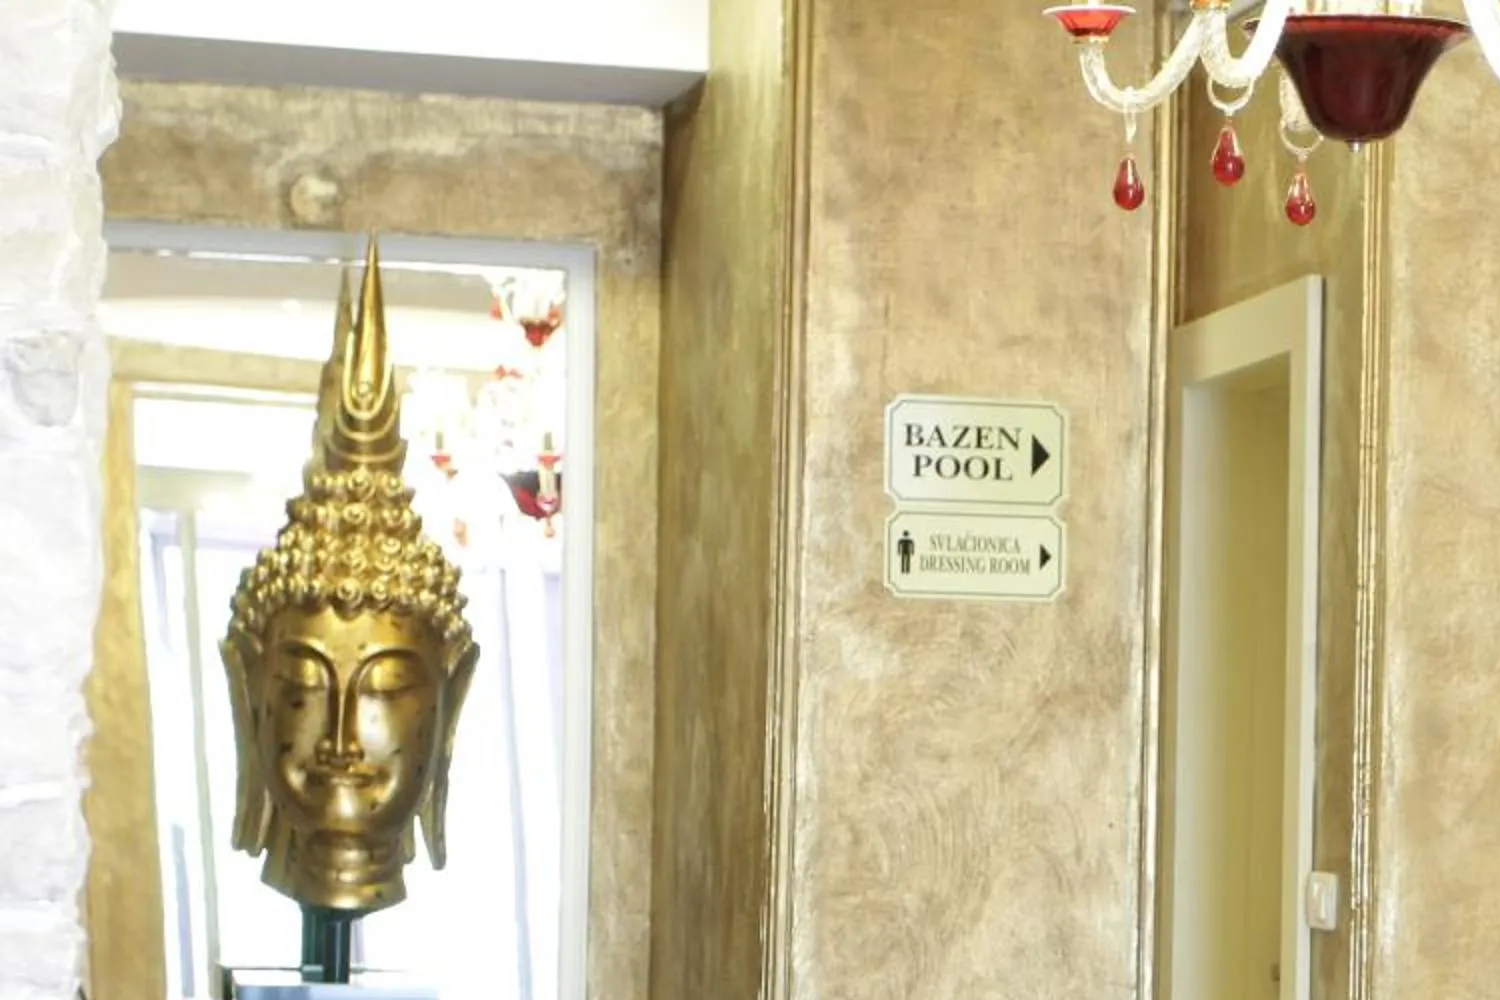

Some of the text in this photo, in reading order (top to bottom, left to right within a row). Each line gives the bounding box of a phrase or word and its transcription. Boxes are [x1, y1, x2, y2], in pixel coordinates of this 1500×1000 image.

[904, 423, 1022, 451] BAZEN
[912, 454, 1013, 481] POOL
[919, 555, 1031, 577] DRESSING ROOM
